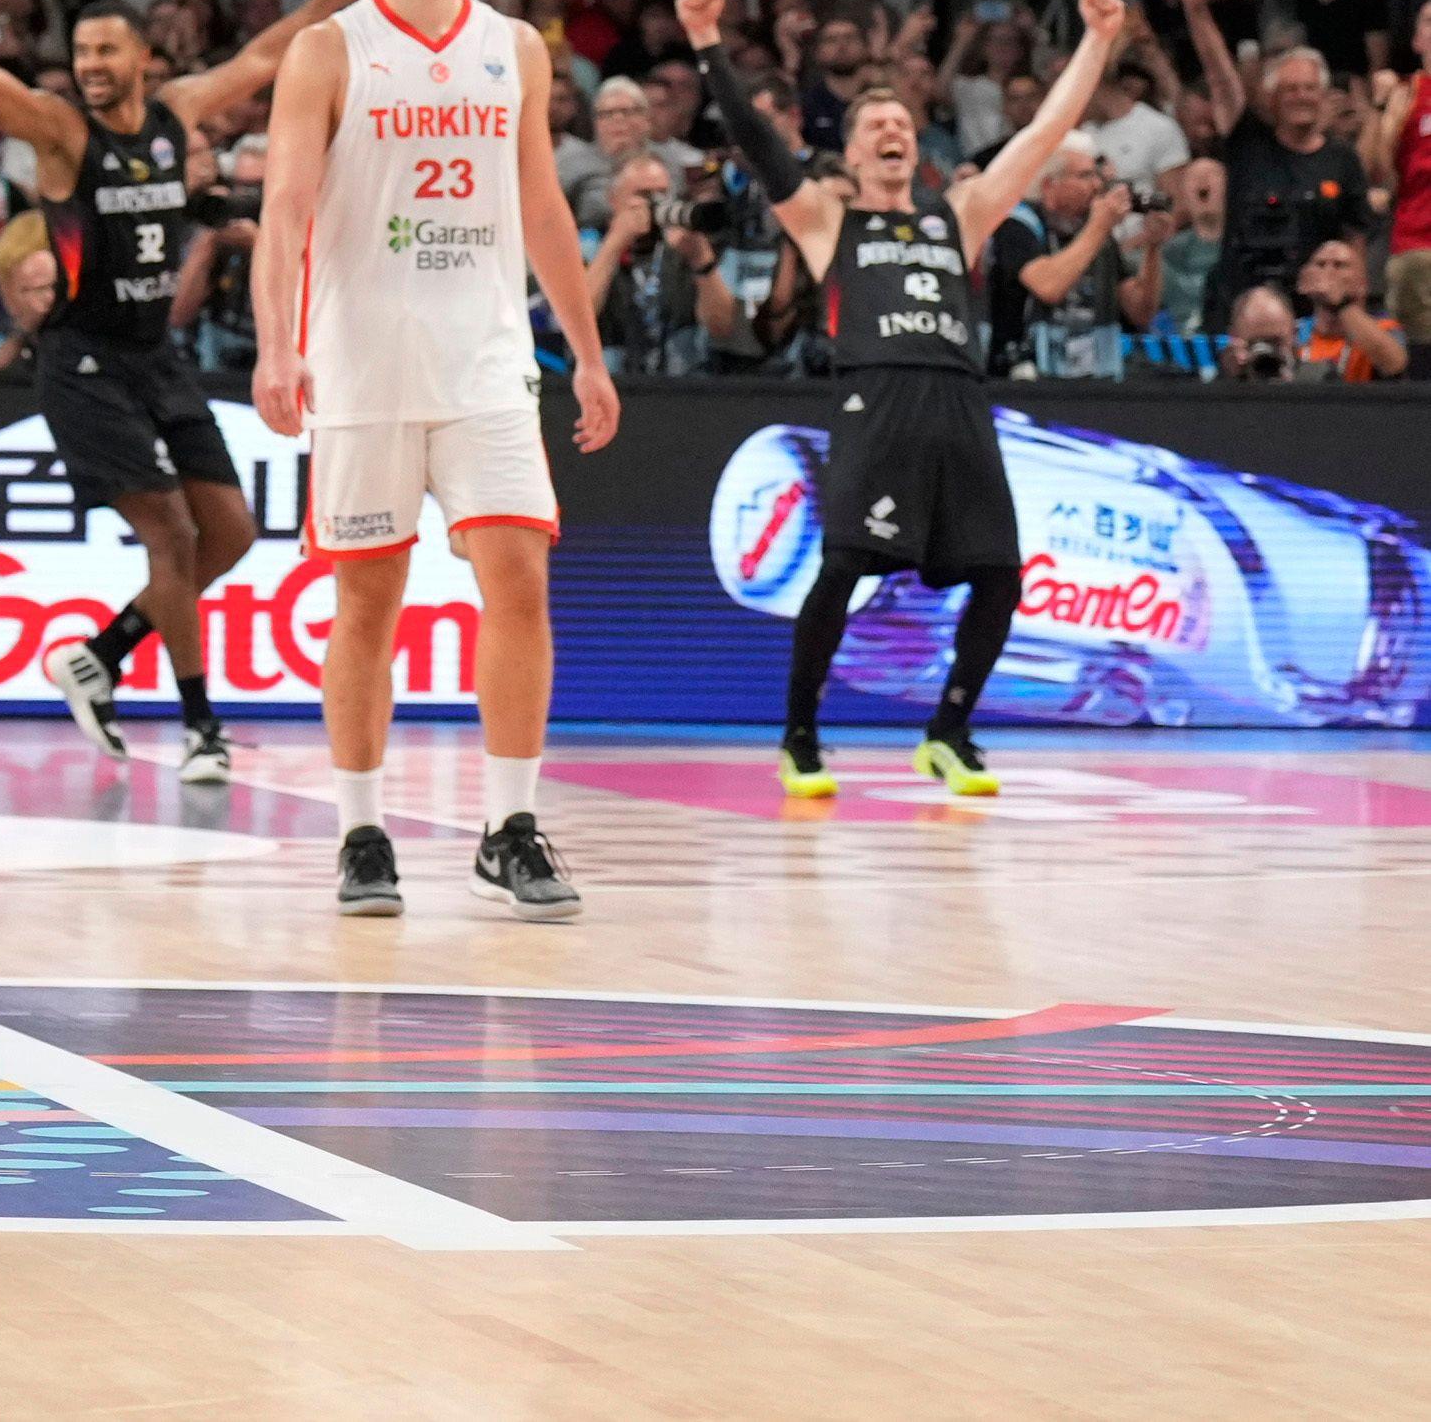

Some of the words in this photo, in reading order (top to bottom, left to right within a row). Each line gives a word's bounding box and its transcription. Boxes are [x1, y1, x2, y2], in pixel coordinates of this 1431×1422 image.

[368, 96, 509, 140] TÜRKİYE
[414, 157, 477, 199] 23
[414, 218, 496, 247] Garanti
[415, 250, 477, 271] BBVA
